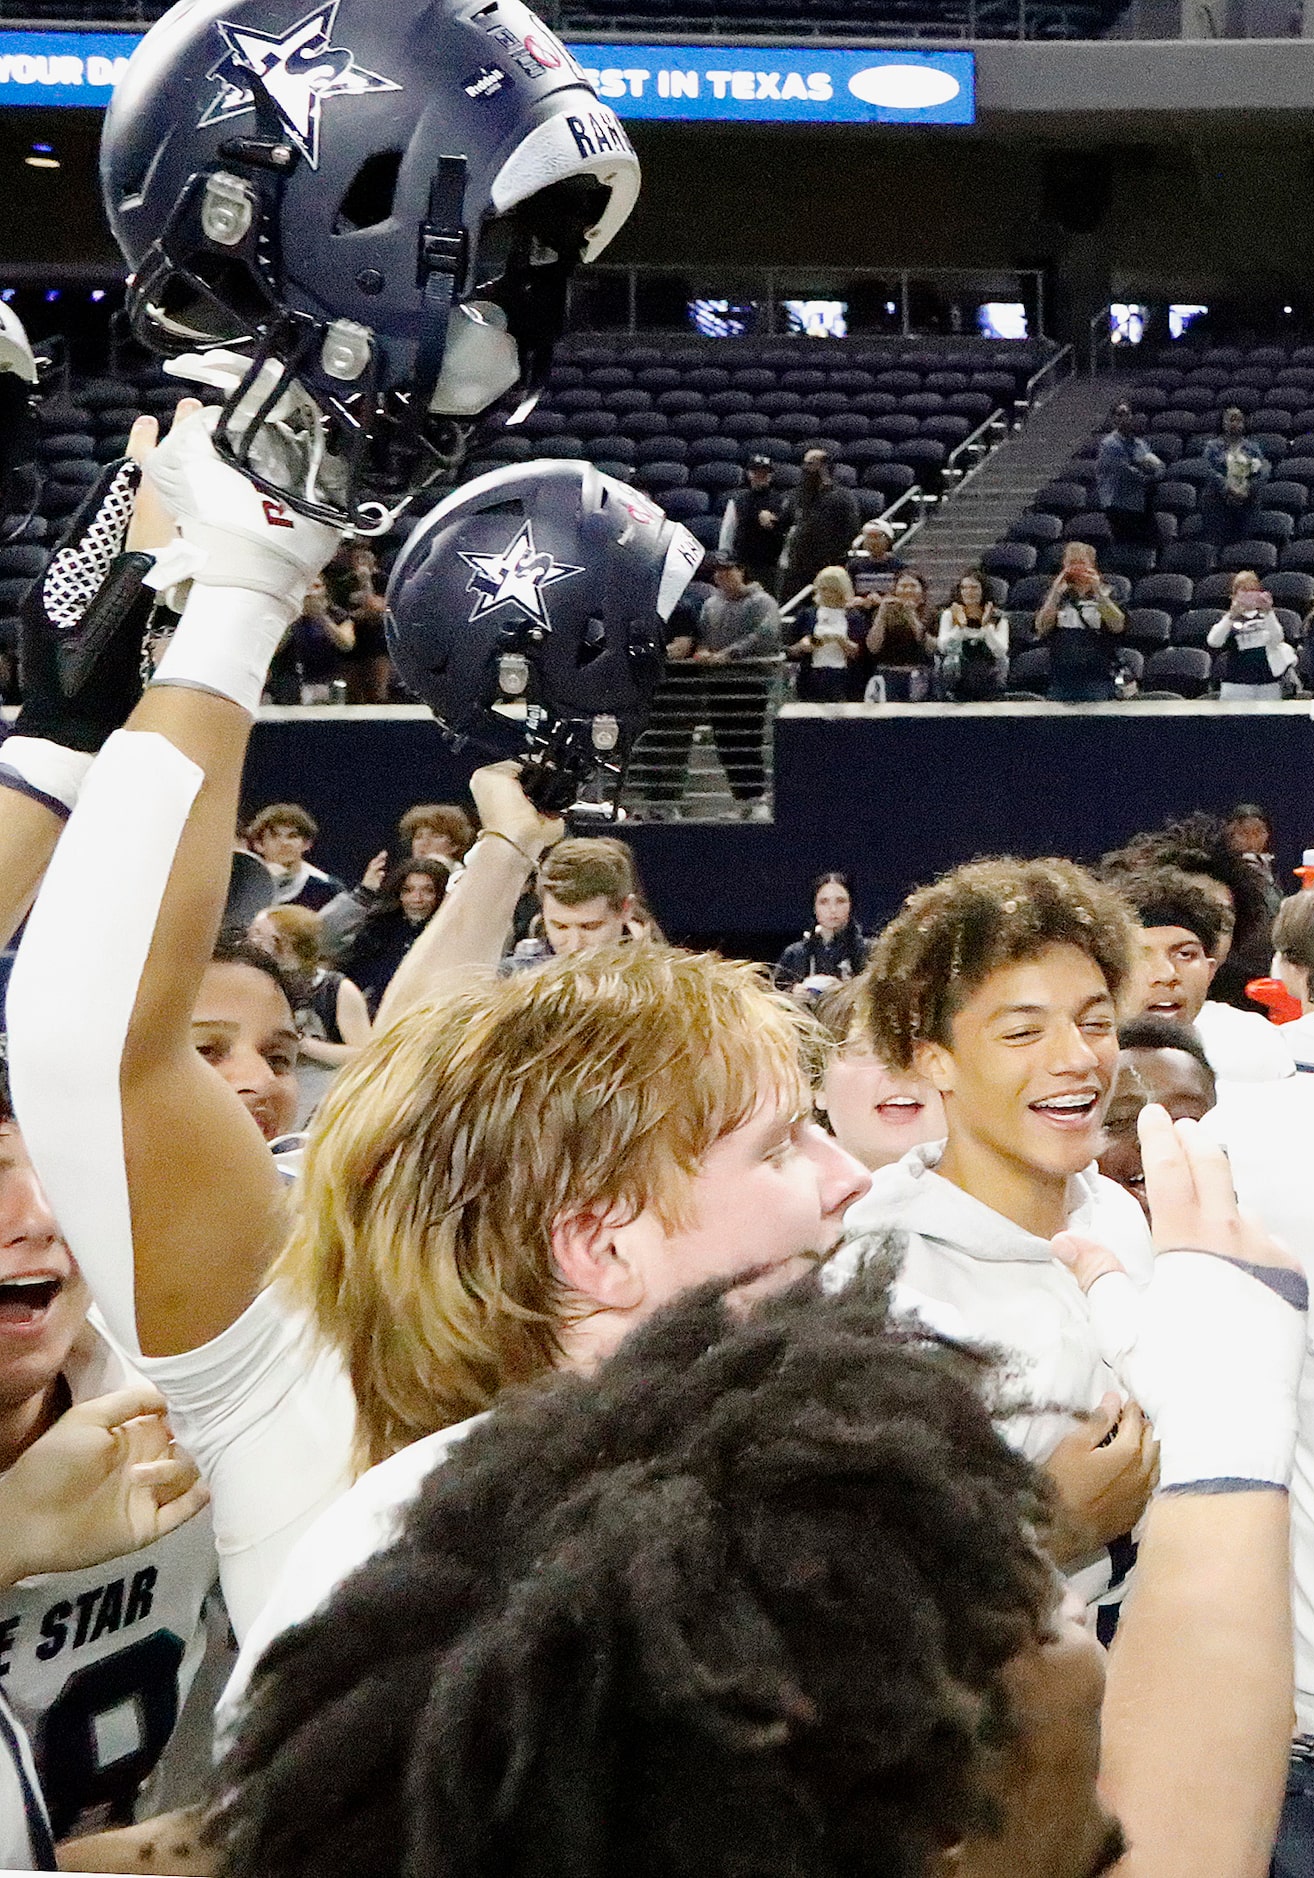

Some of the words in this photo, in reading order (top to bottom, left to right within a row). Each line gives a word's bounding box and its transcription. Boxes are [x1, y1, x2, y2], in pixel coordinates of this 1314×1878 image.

[658, 70, 699, 98] IN
[705, 71, 834, 100] TEXAS
[35, 1565, 159, 1662] STAR
